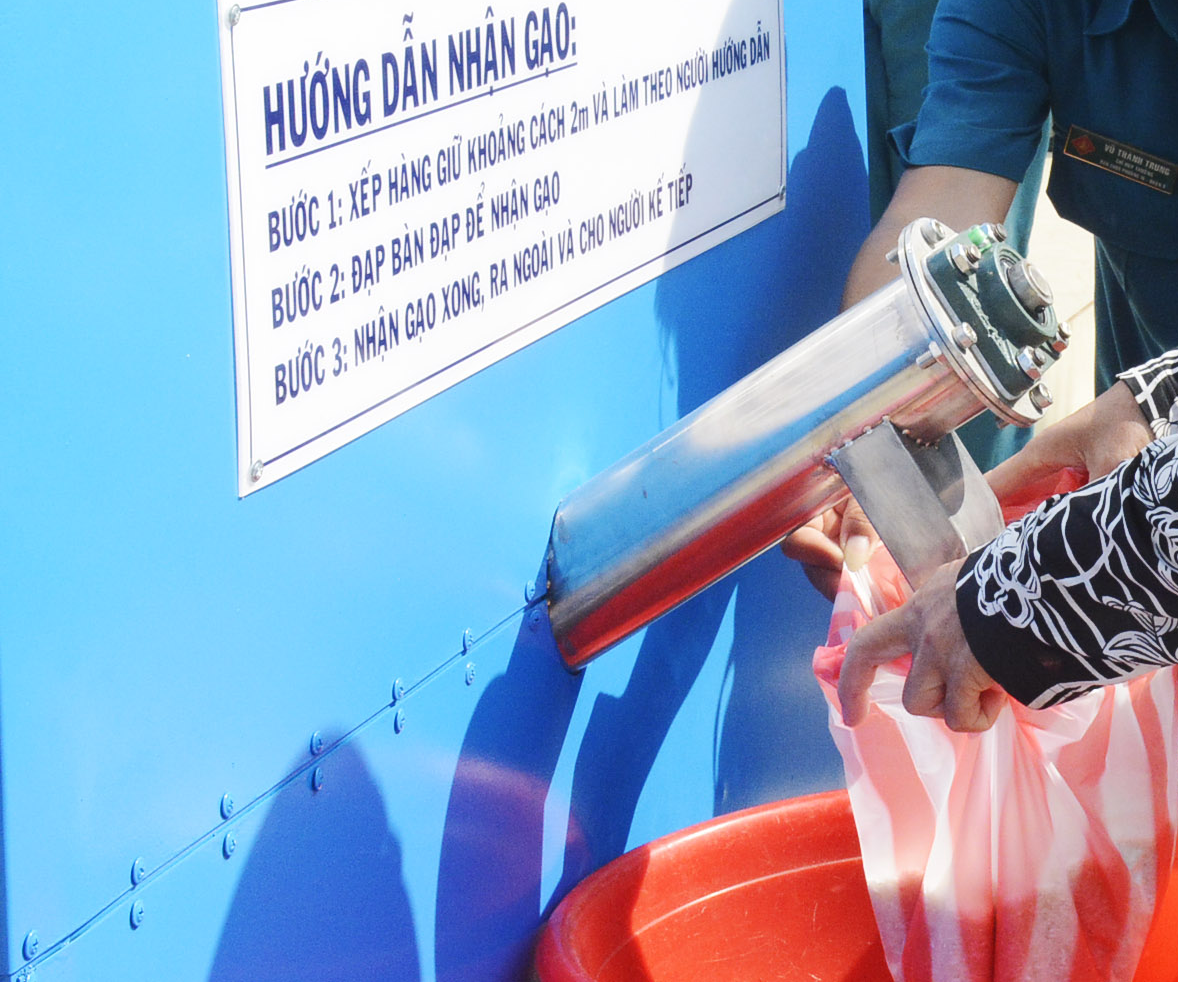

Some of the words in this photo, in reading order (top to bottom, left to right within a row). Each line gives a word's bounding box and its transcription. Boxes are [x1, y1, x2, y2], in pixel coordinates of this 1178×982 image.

[263, 51, 372, 156] HƯỚNG
[382, 11, 438, 118] DẪN
[448, 6, 516, 96] NHẬN
[524, 2, 577, 78] GẠO:
[268, 189, 320, 253] BƯỚC
[327, 189, 343, 230] 1:
[348, 159, 382, 222] XẾP
[388, 153, 432, 206] HÀNG
[436, 134, 463, 187] GIỮ
[467, 113, 525, 175] KHOẢNG
[529, 102, 565, 150] CÁCH
[570, 100, 589, 135] 2m
[592, 81, 609, 125] VÀ
[613, 74, 639, 118] LÀM
[642, 66, 673, 107] THEO
[676, 47, 709, 95] NGƯỜI
[711, 36, 747, 80] HƯỚNG
[750, 20, 771, 65] DẪN
[1145, 160, 1170, 176] TRUNG
[271, 264, 323, 330] BƯỚC
[329, 263, 346, 305] 2:
[351, 244, 385, 296] ĐẠP
[391, 223, 424, 277] BÀN
[430, 213, 460, 261] ĐẠP
[466, 181, 486, 243] ĐỂ
[490, 178, 529, 232] NHẬN
[533, 171, 561, 217] GẠO
[274, 340, 325, 406] BƯỚC
[332, 337, 348, 377] 3:
[353, 305, 400, 367] NHẬN
[405, 292, 436, 343] GẠO
[441, 271, 485, 323] XONG,
[490, 258, 508, 300] RA
[513, 230, 554, 288] NGOÀI
[557, 219, 575, 265] VÀ
[579, 213, 604, 255] CHO
[608, 188, 645, 242] NGƯỜI
[648, 172, 663, 222] KẾ
[667, 163, 693, 212] TIẾP
